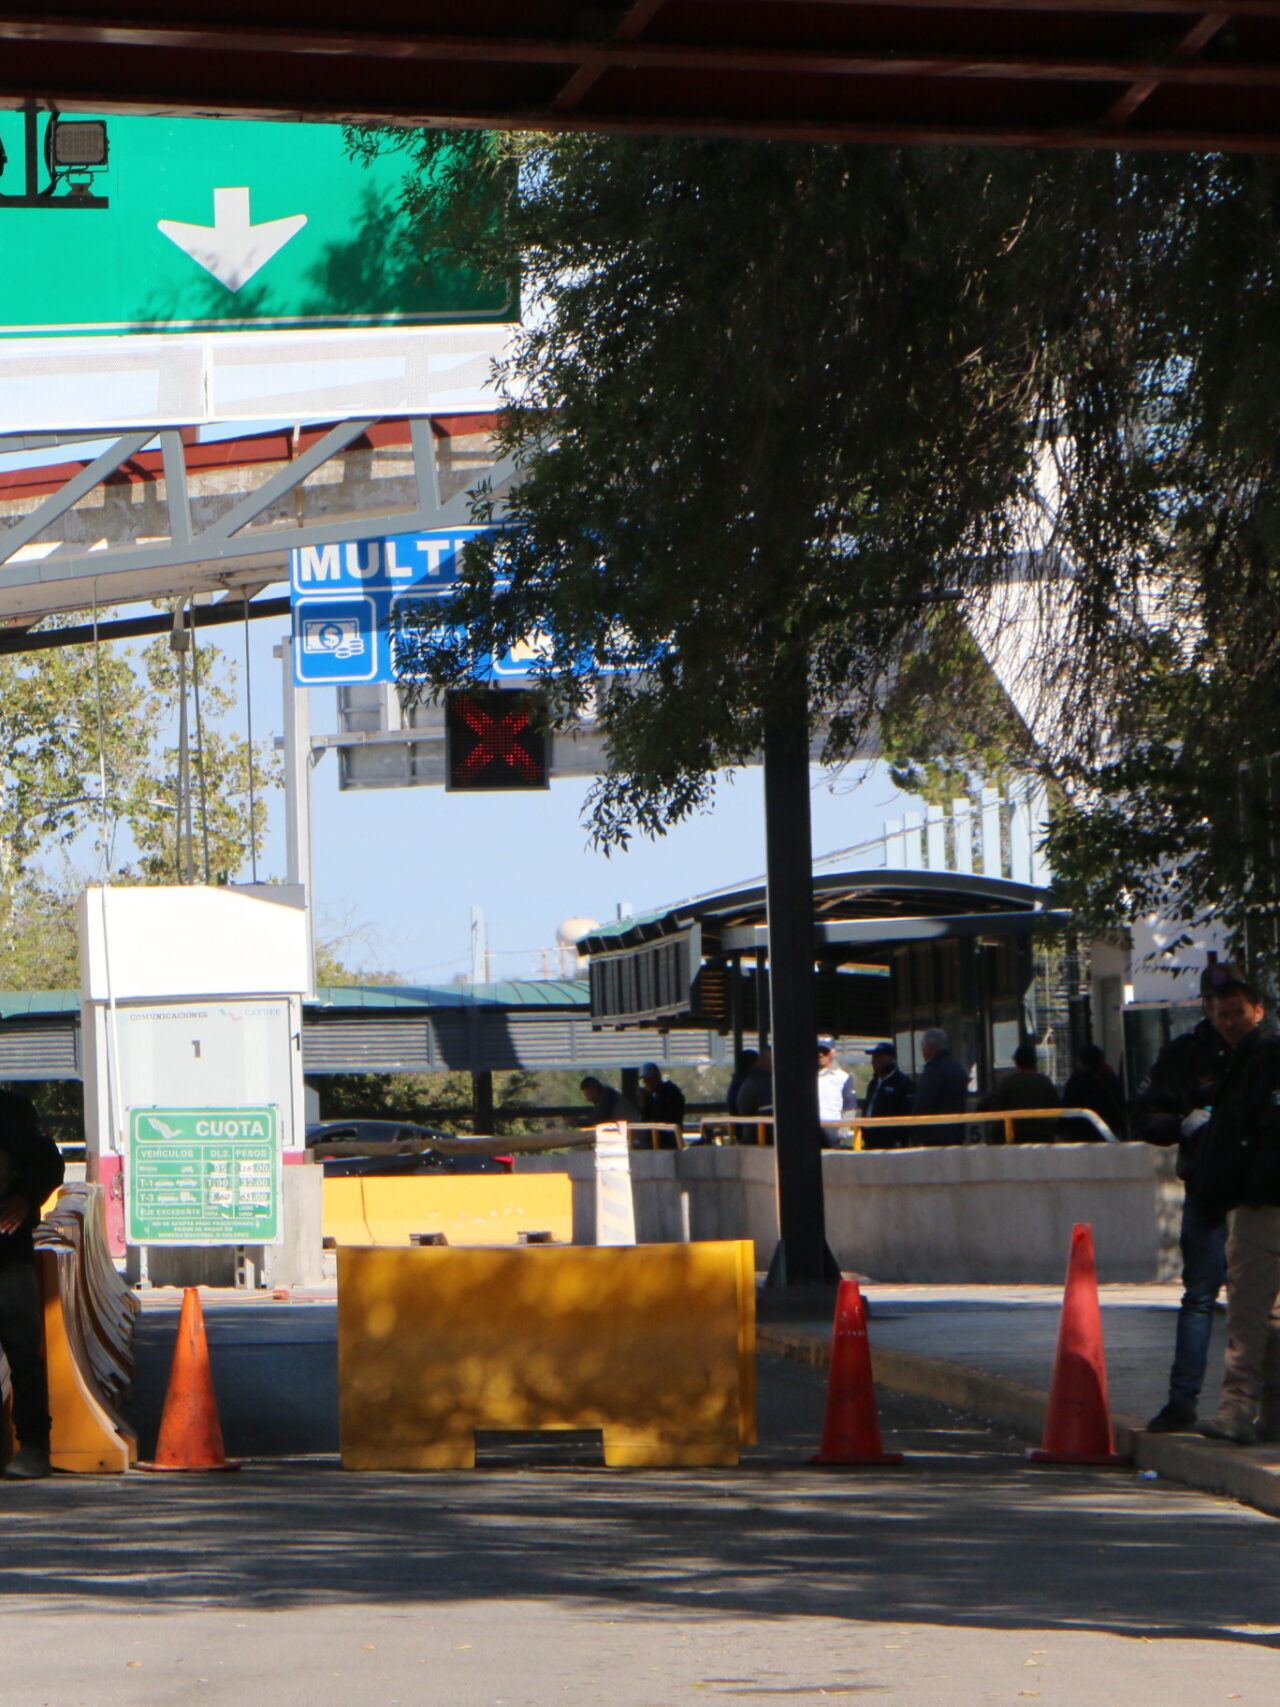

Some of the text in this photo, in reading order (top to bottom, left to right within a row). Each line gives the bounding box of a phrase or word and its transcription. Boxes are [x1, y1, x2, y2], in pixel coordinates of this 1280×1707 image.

[300, 538, 467, 582] MULTI
[130, 1011, 208, 1021] COMUNICACIONES
[191, 1039, 202, 1059] 1
[291, 1031, 301, 1052] 1
[195, 1120, 265, 1138] CUOTA
